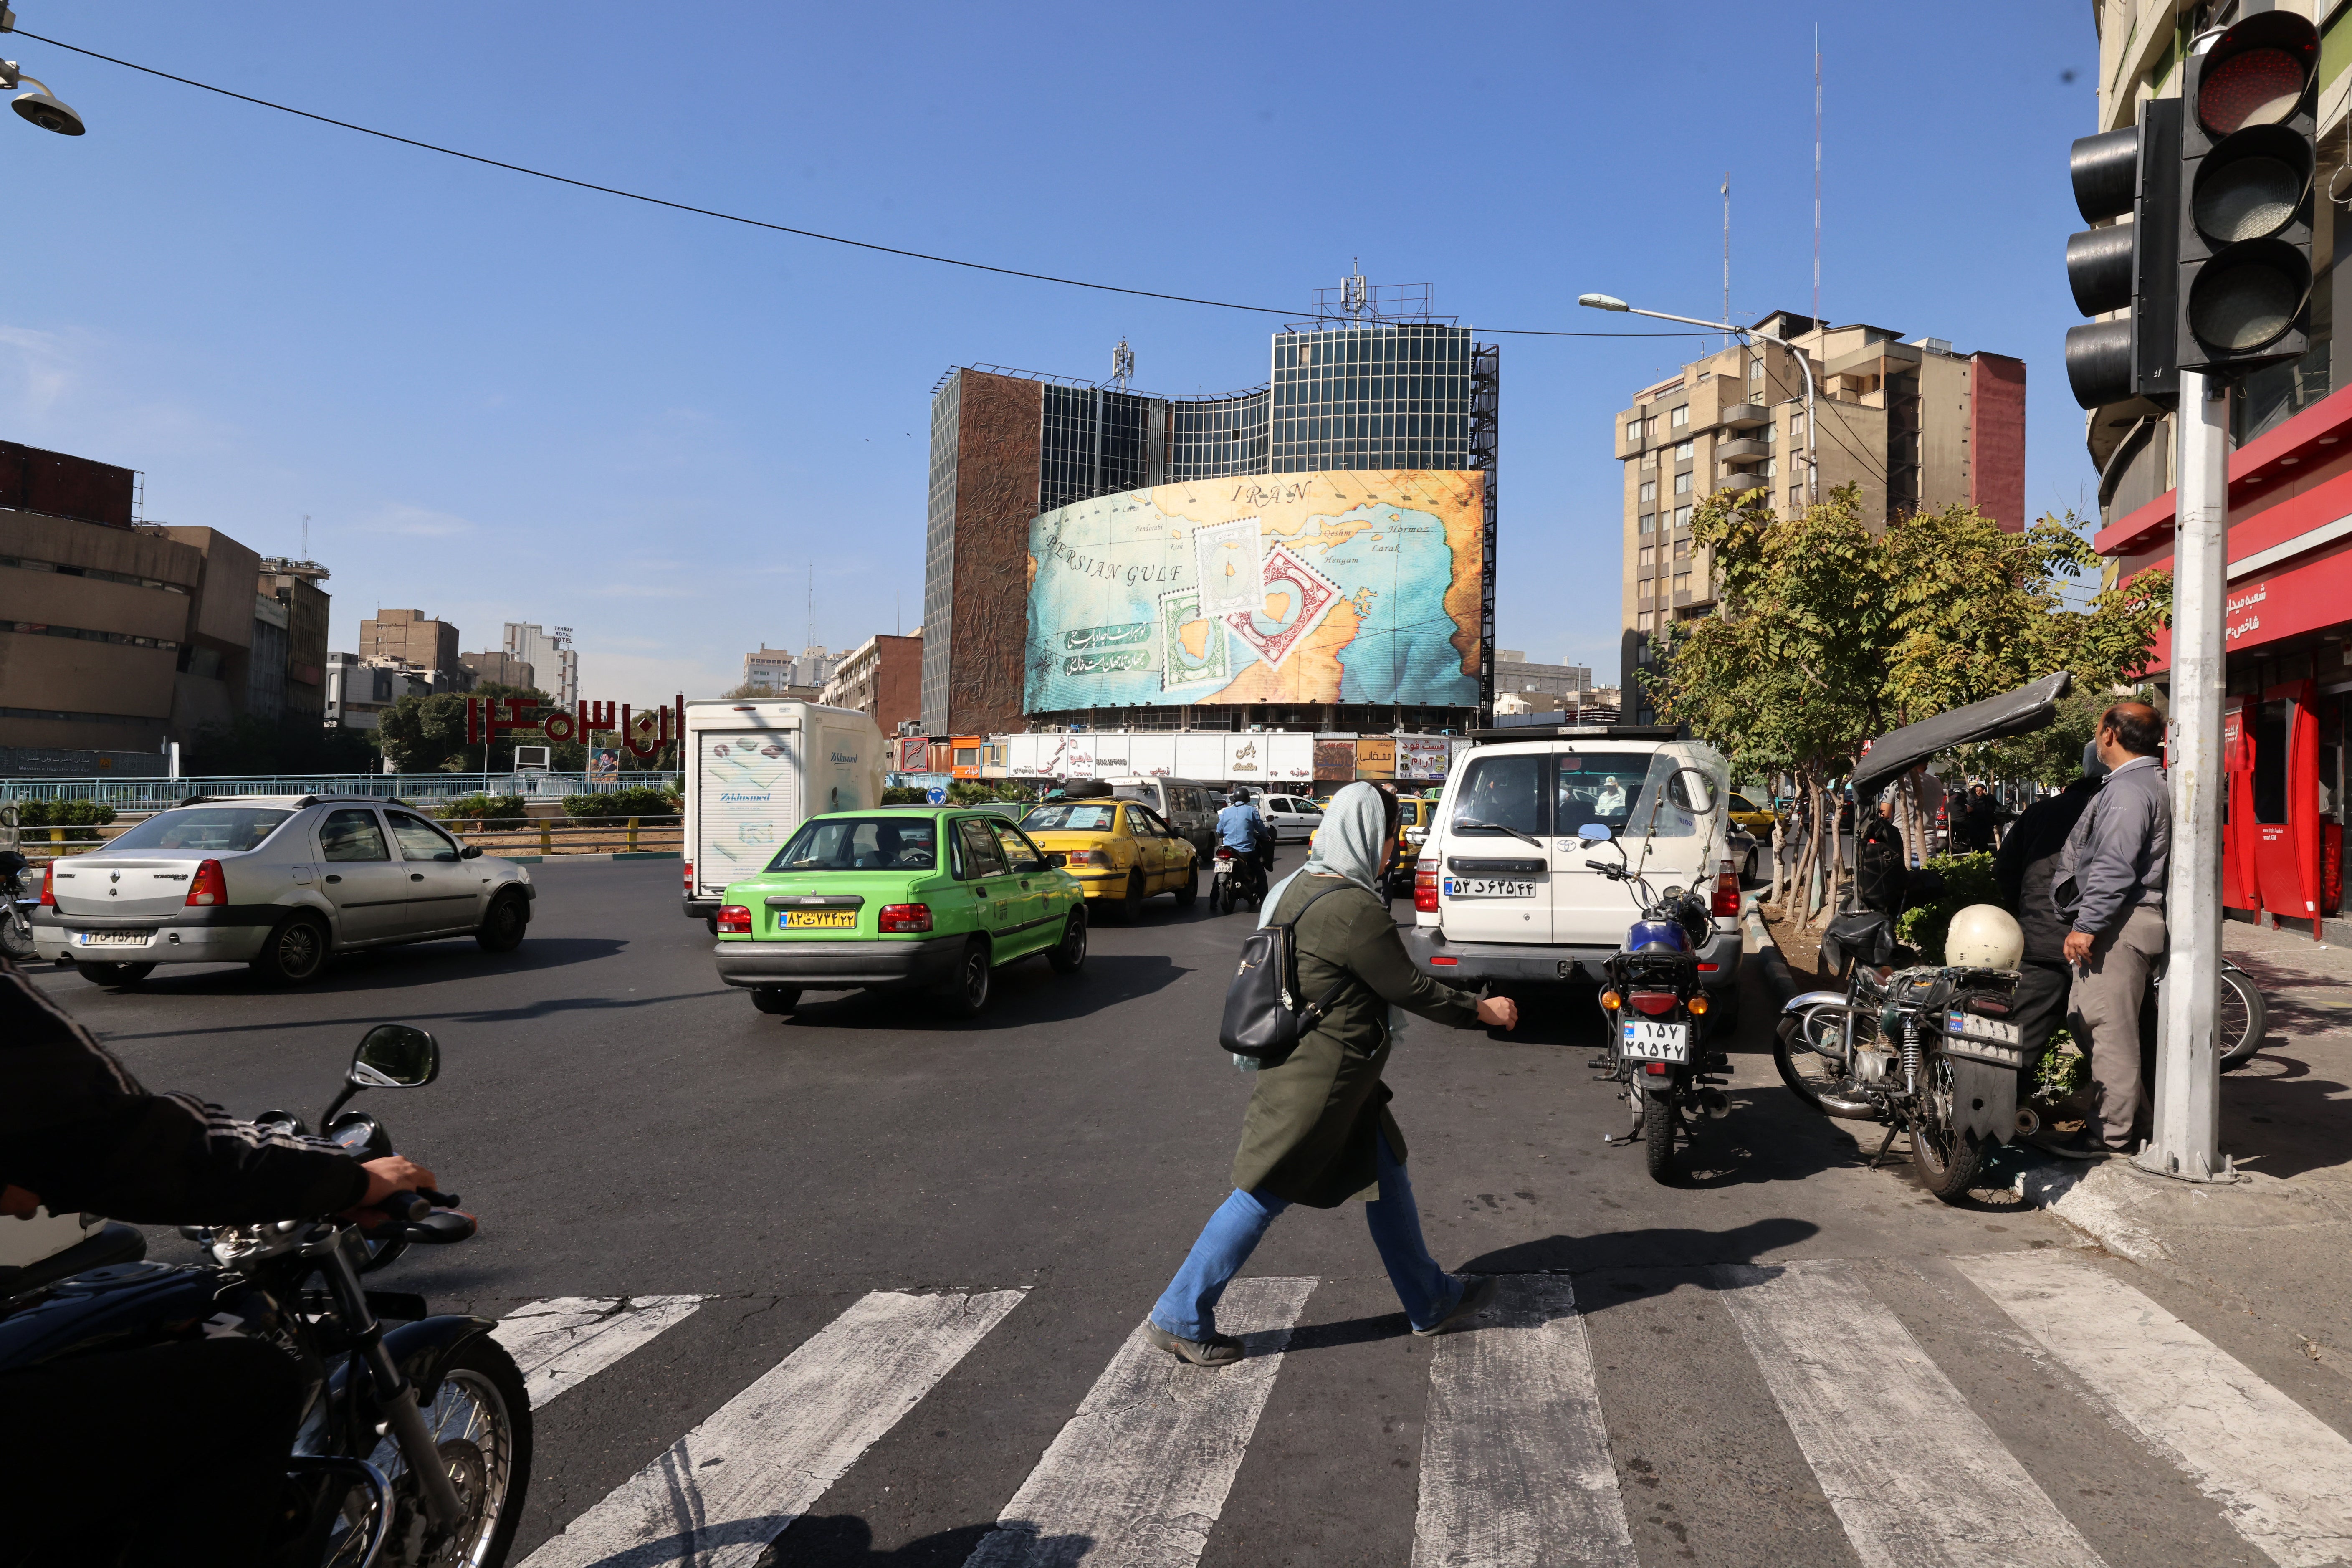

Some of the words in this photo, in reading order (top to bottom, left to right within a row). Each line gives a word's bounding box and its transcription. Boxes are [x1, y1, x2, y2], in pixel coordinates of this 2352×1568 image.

[1231, 481, 1312, 508] IRAN
[1135, 524, 1163, 532] Hendorabi
[1324, 528, 1351, 538] Qeshm
[1371, 544, 1402, 553] Larak
[1047, 534, 1121, 579] PERSIAN
[1127, 564, 1182, 587] GULF
[1324, 556, 1359, 565] Hengam
[2245, 583, 2266, 610] شعبه
[1140, 621, 1147, 637] تو
[1085, 655, 1105, 670] است
[1103, 654, 1121, 672] جهان
[1123, 652, 1145, 670] جهان
[1402, 740, 1420, 751] فود
[1421, 741, 1445, 750] فست
[1411, 757, 1434, 768] آرام
[1290, 768, 1309, 777] موزه
[720, 793, 771, 803] Zyklusmed
[1517, 883, 1533, 895] ۴۴
[840, 915, 854, 926] ۲۲
[1646, 1023, 1678, 1039] ۱۵۷
[1625, 1041, 1684, 1059] ۲۹۵۴۷
